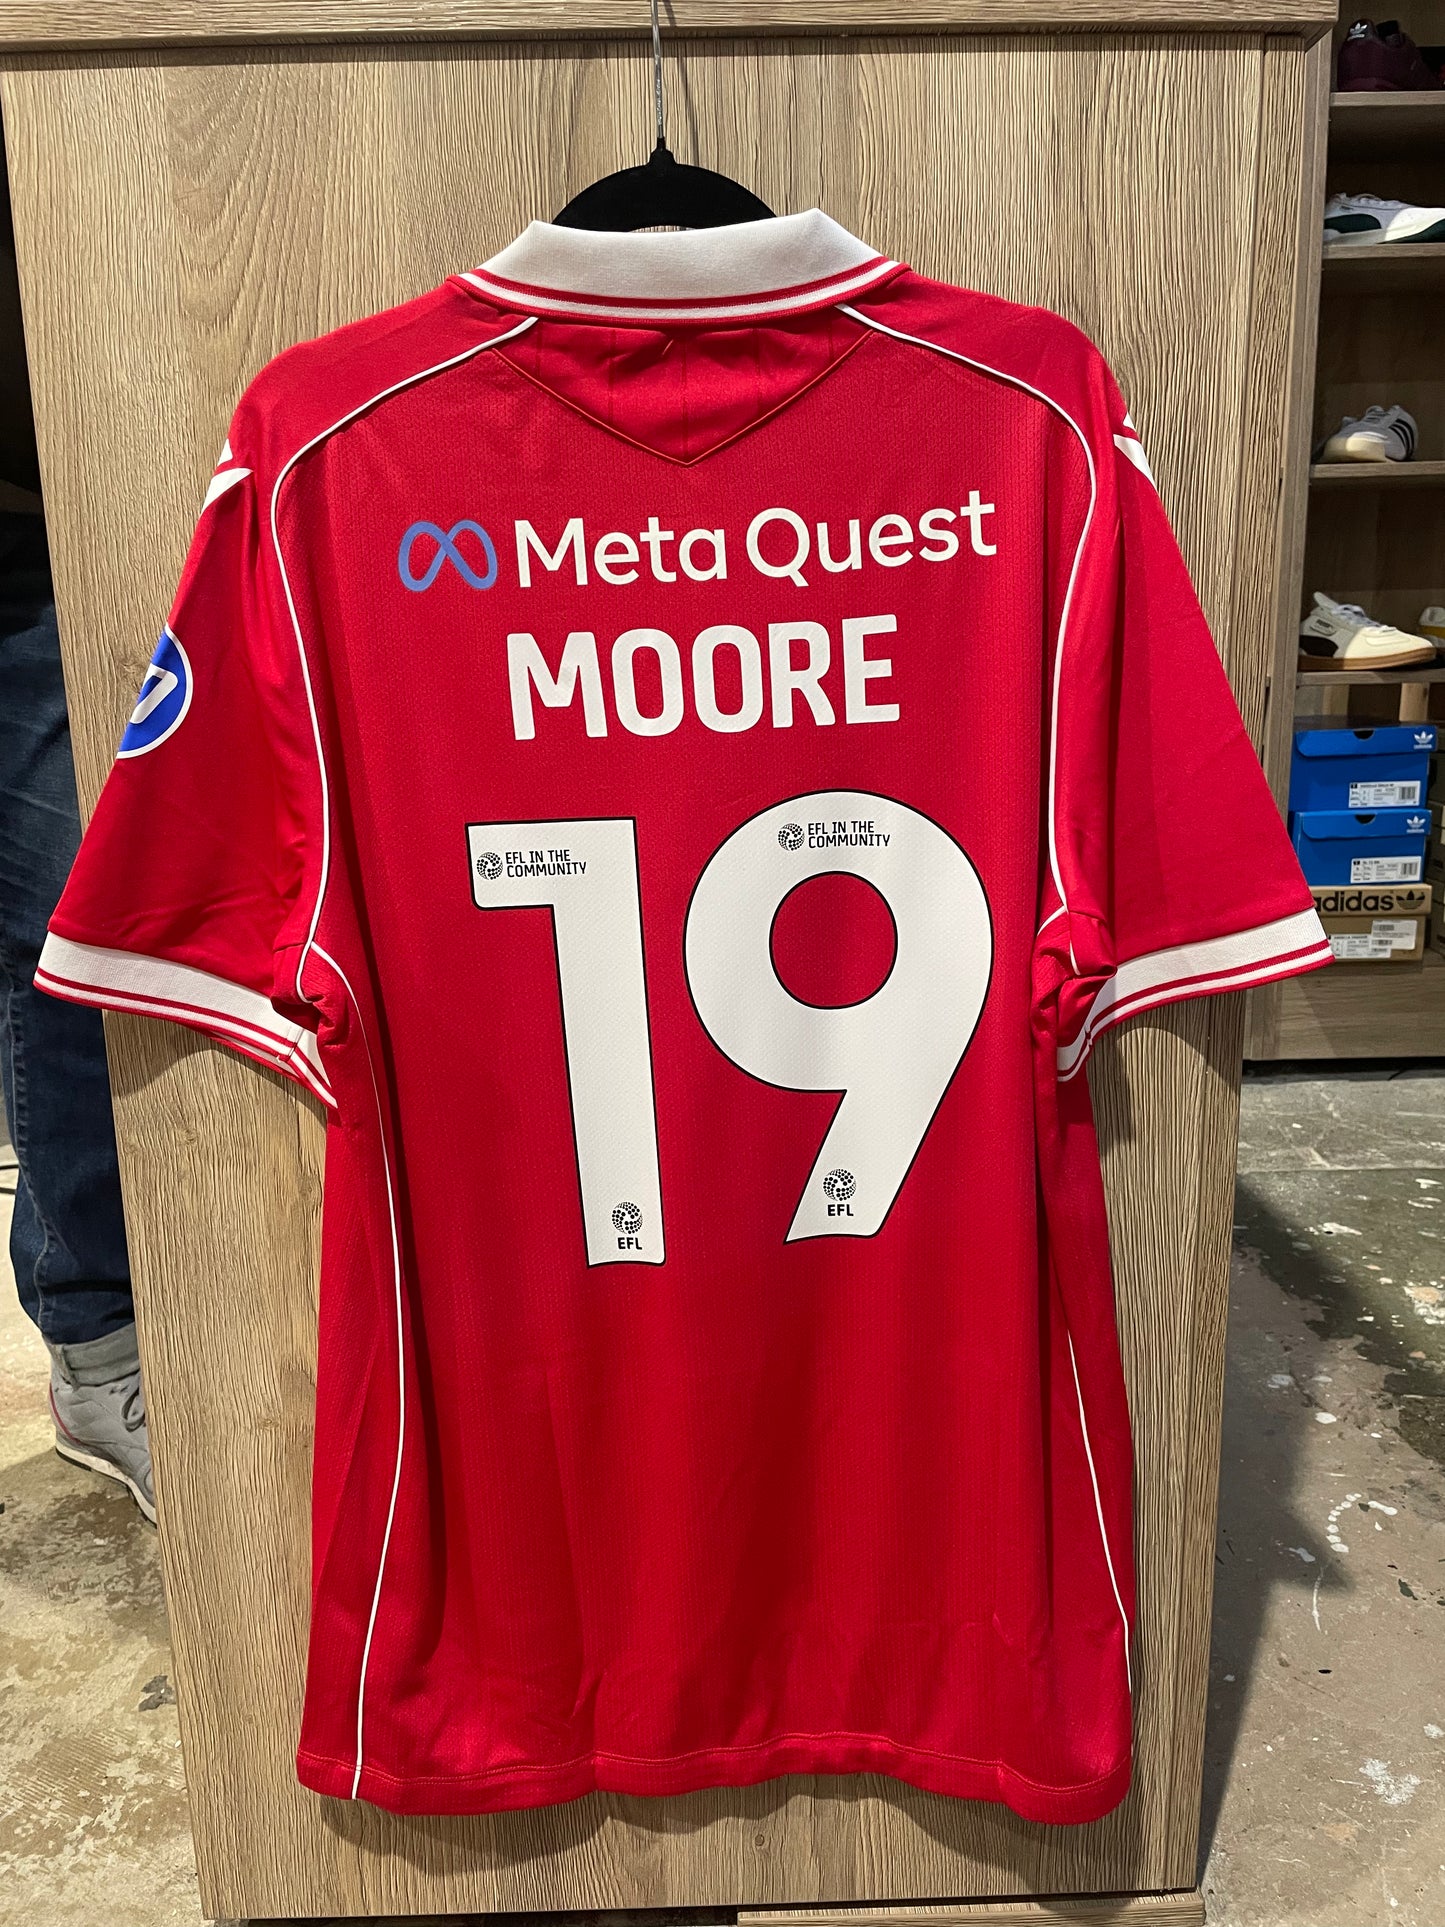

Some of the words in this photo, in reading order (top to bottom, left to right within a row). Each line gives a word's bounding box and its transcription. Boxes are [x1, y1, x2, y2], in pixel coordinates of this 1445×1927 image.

[514, 516, 727, 588] Meta
[745, 490, 997, 587] Quest
[506, 614, 900, 740] MOORE
[808, 823, 829, 835] EFL
[832, 821, 847, 833] IN
[851, 820, 875, 833] THE
[808, 834, 891, 848] COMMUNITY
[505, 851, 526, 864] EFL
[529, 850, 544, 863] IN
[547, 849, 571, 862] THE
[506, 861, 587, 877] COMMUNITY
[465, 789, 994, 1267] 19
[828, 1204, 854, 1216] EFL
[617, 1237, 643, 1250] EFL
